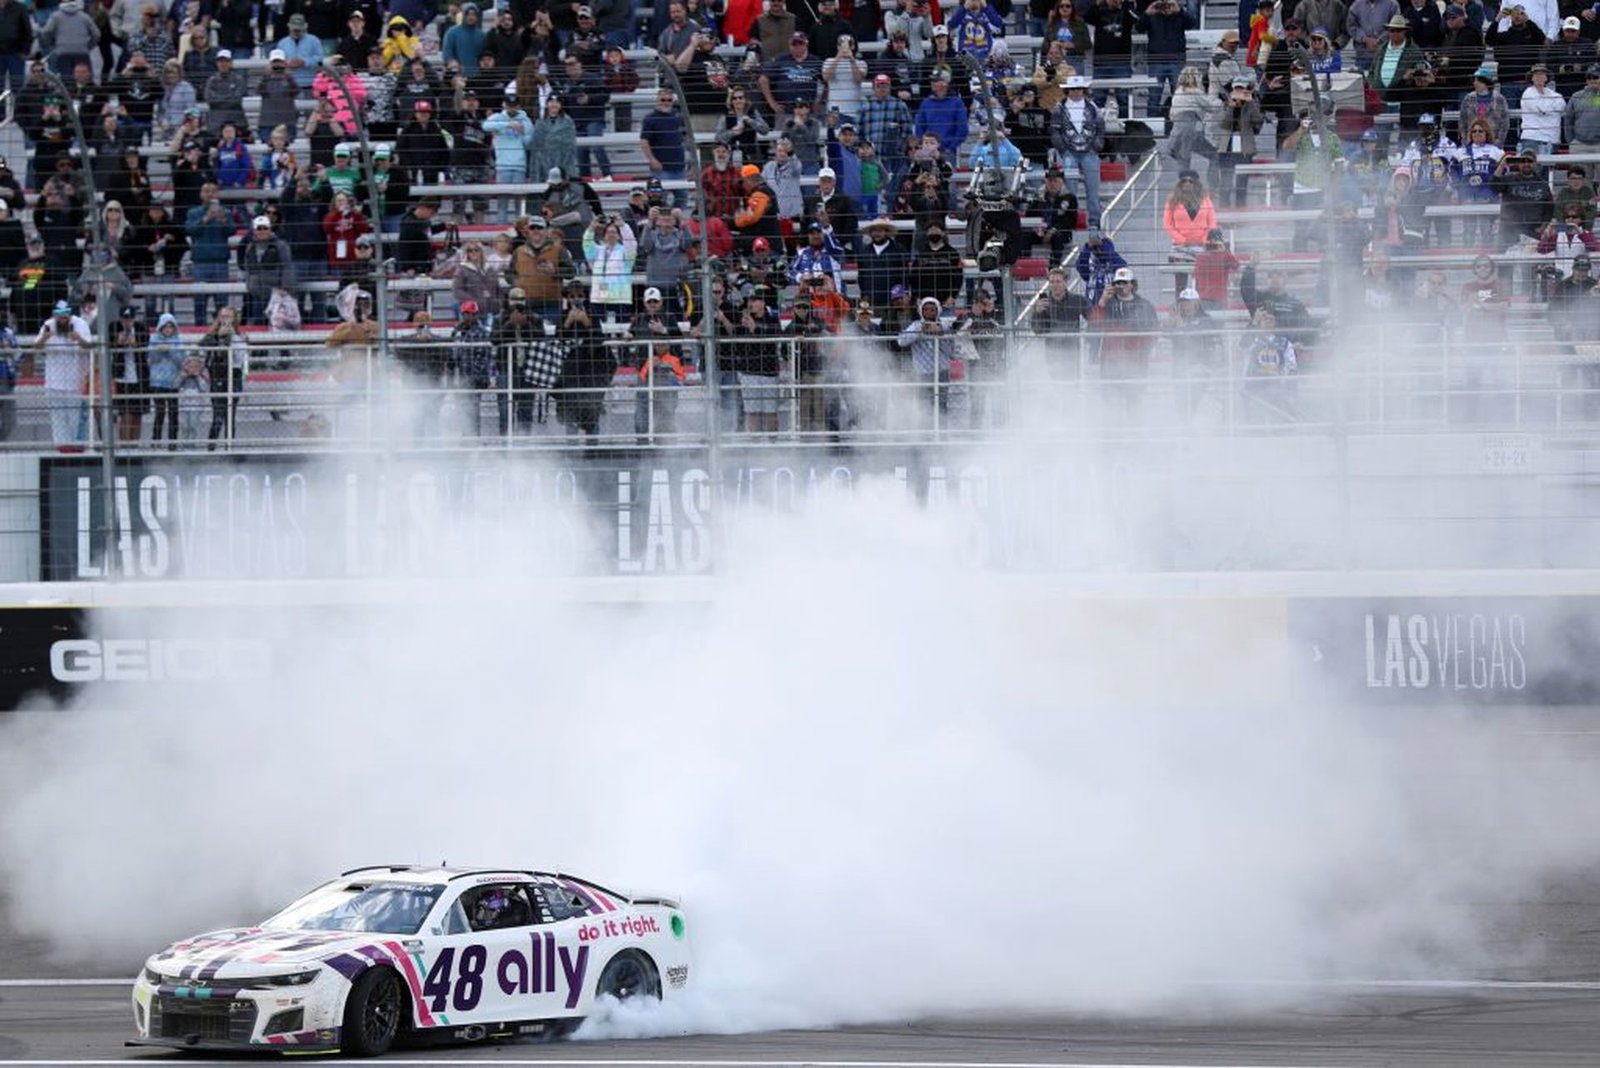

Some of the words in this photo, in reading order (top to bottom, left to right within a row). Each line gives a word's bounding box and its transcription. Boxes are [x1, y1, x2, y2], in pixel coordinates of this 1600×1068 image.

[50, 639, 271, 682] GEICO
[578, 924, 600, 941] do
[603, 919, 619, 937] it
[621, 915, 660, 937] right.
[423, 944, 487, 1012] 48
[497, 931, 590, 1009] ally
